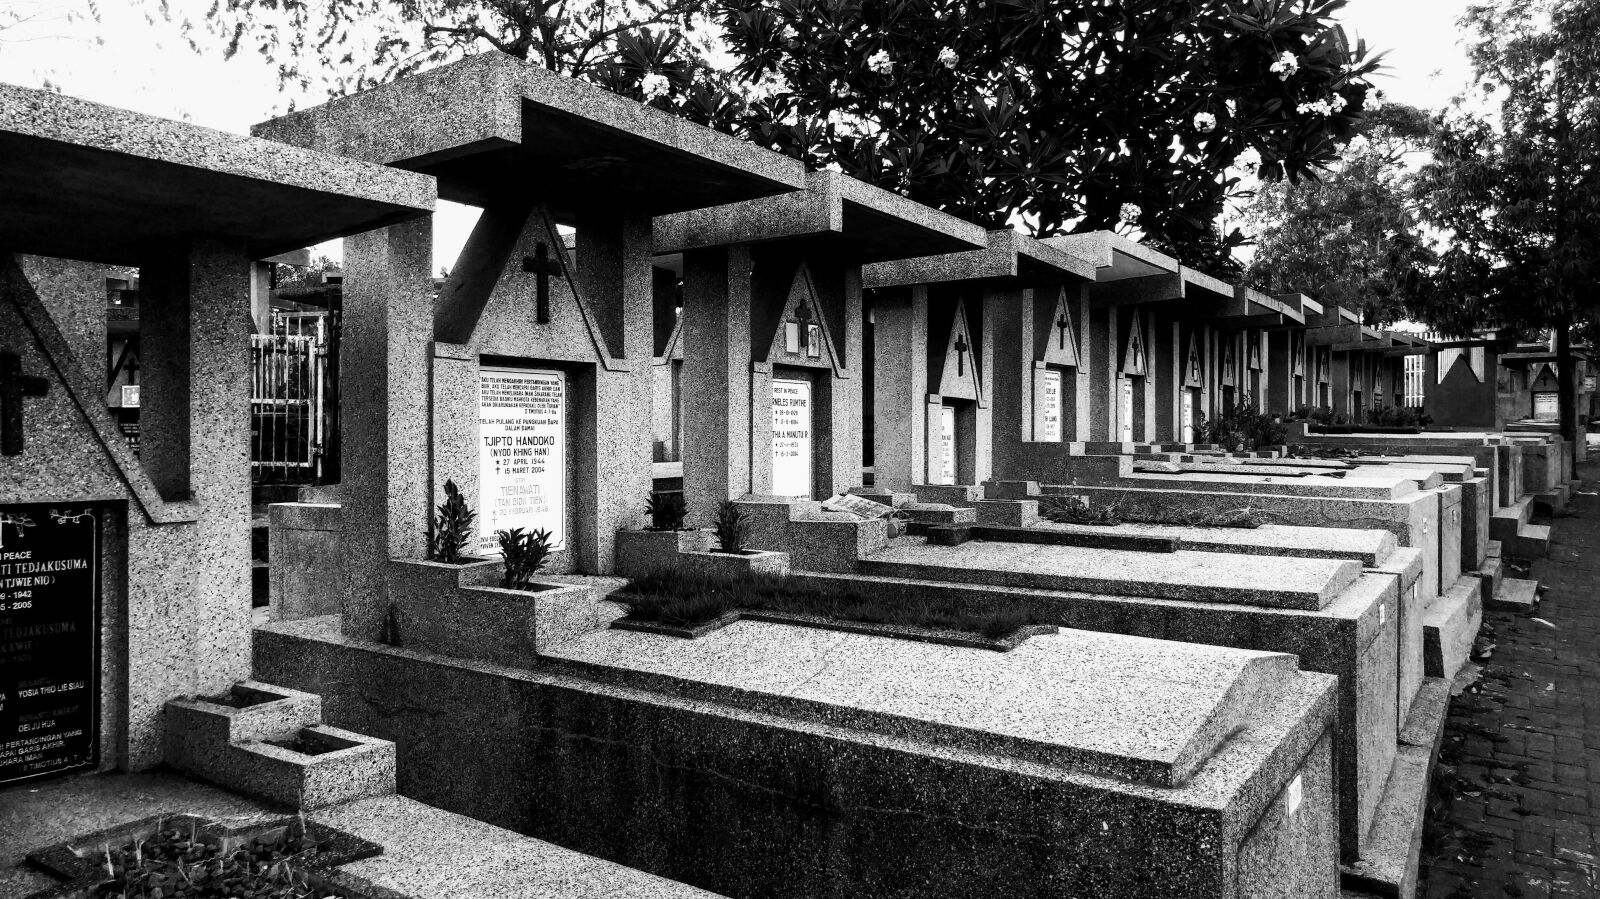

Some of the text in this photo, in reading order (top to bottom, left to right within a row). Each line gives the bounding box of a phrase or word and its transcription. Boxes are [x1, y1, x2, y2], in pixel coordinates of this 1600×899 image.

[484, 436, 555, 446] TJIPTO HANDOKO
[513, 447, 532, 456] KHING
[534, 447, 550, 456] HAN)
[3, 551, 32, 560] PEACE
[15, 558, 88, 575] TEDJAKUSUMA
[5, 577, 32, 588] TJWIE
[13, 590, 32, 599] 1942
[12, 601, 32, 610] 2005
[18, 688, 39, 698] YOSIA
[57, 683, 68, 692] LIE
[63, 729, 83, 738] YANG
